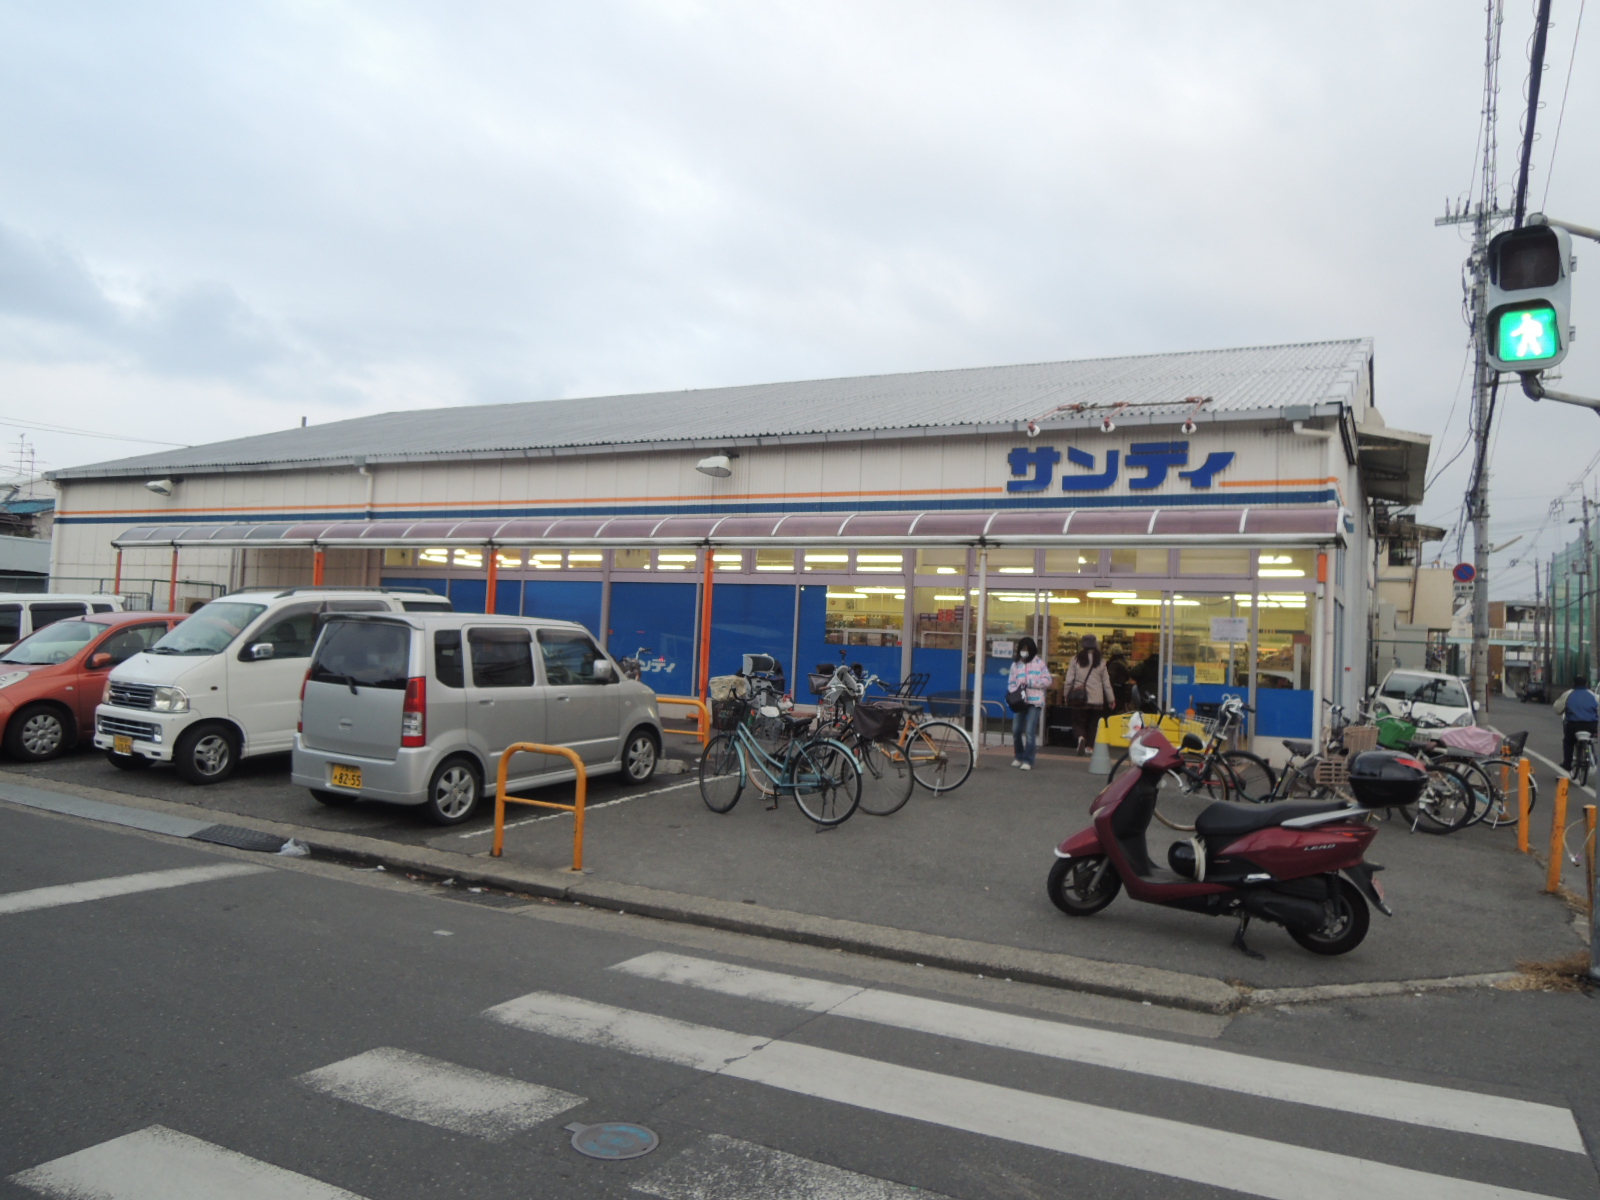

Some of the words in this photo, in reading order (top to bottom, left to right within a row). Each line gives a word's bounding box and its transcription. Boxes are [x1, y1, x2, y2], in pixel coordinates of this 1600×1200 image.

[1006, 440, 1236, 493] サンディ
[1303, 843, 1337, 852] LEAD
